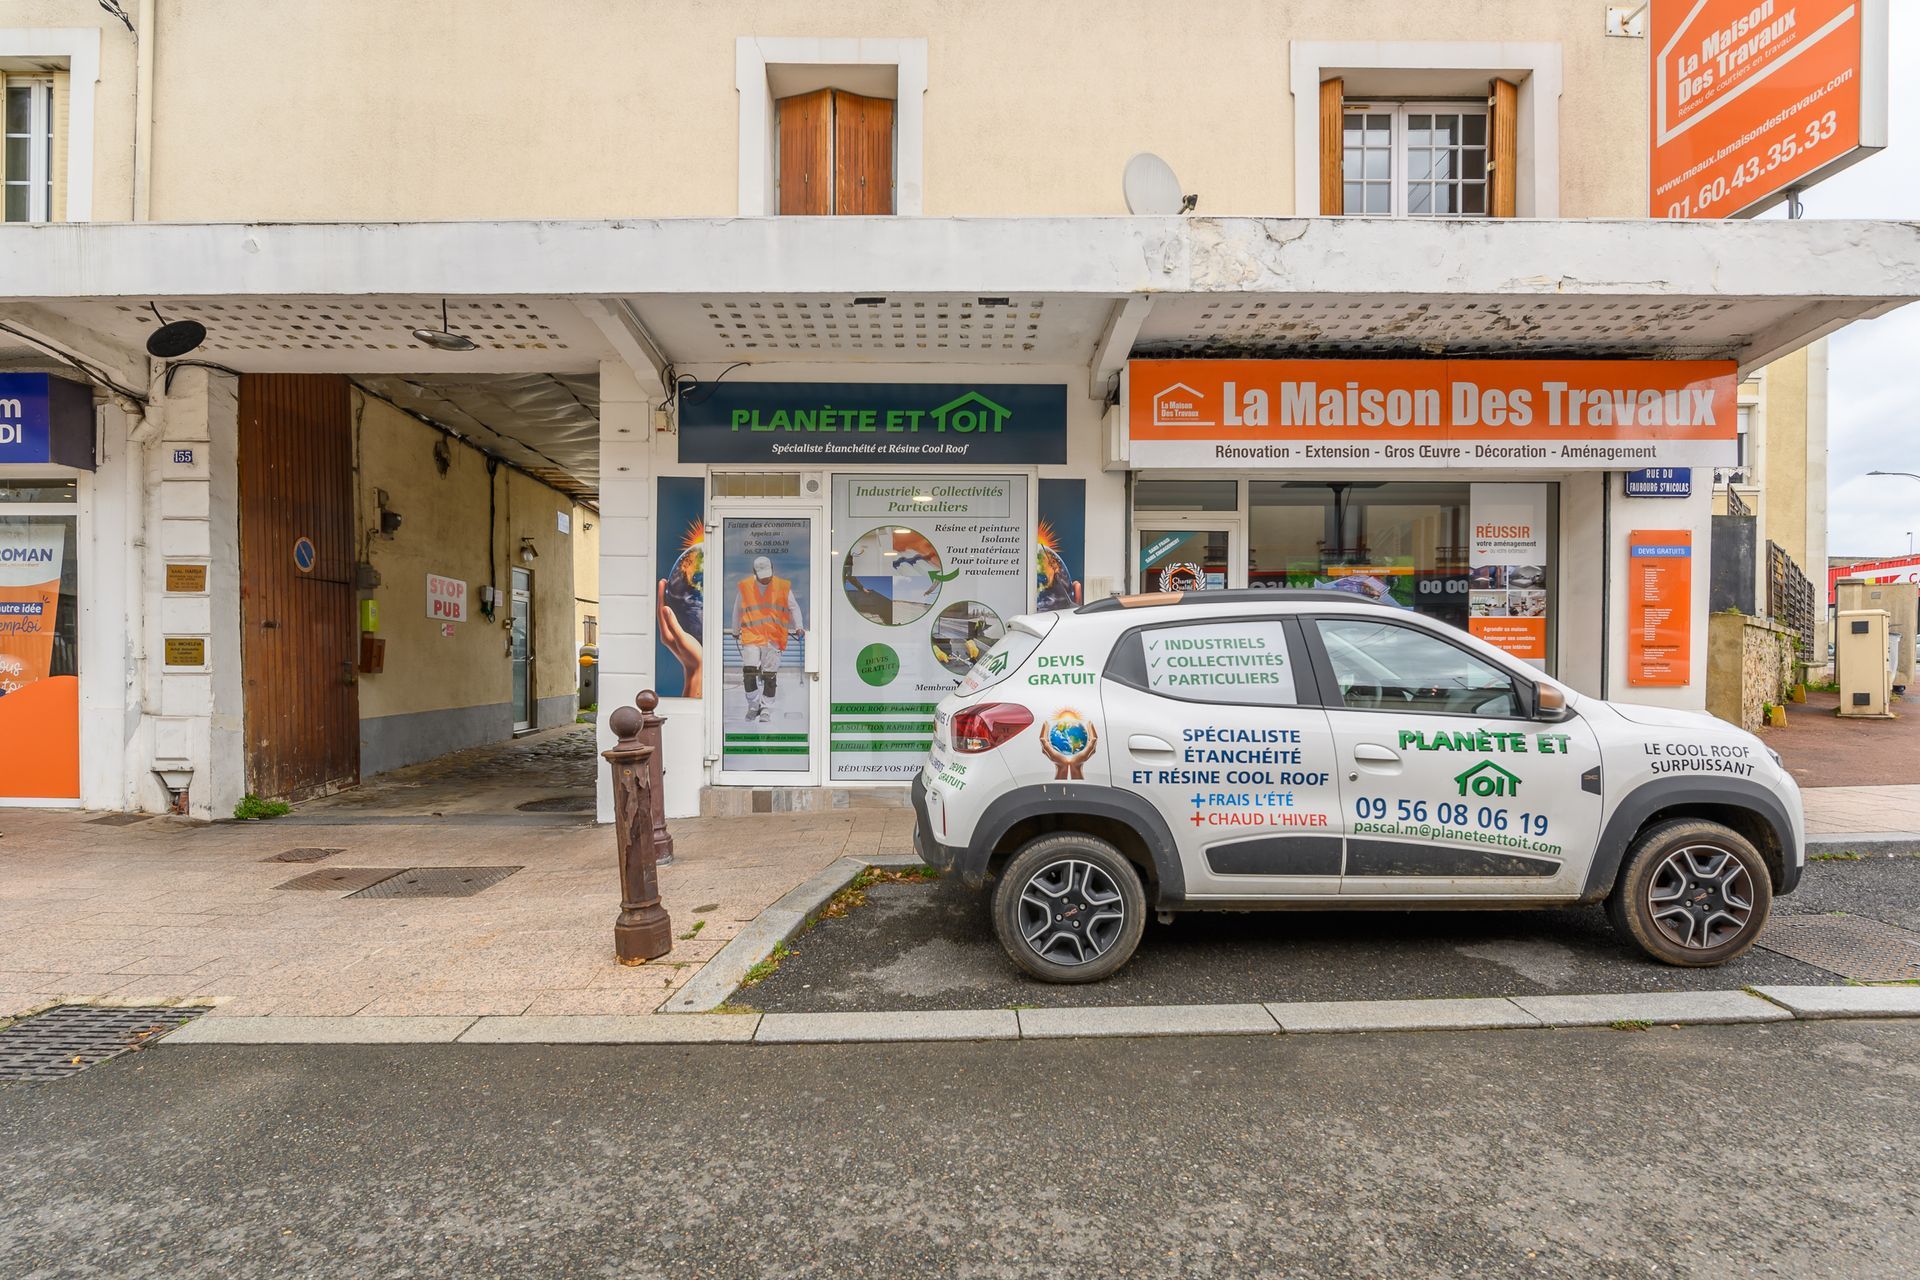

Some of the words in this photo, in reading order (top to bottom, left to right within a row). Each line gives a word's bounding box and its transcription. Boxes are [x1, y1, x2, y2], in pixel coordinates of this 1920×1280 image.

[1678, 54, 1698, 81] La
[1702, 0, 1774, 64] Maison
[1678, 68, 1713, 106] Des
[1716, 8, 1796, 78] Travaux
[1678, 97, 1704, 118] Réseau
[1705, 89, 1715, 100] de
[1716, 64, 1751, 92] courtiers
[1752, 56, 1763, 68] en
[1765, 32, 1796, 58] travaux
[1656, 67, 1853, 196] www.meaux.lamaisondestravaux.com
[1667, 110, 1837, 219] 01.60.43.35.33
[1223, 382, 1269, 426] La
[1280, 382, 1440, 426] Maison
[1452, 382, 1533, 426] Des
[1542, 382, 1716, 426] Travaux
[731, 405, 877, 434] PLANÈTE
[886, 410, 925, 433] ET
[929, 391, 1012, 433] TOIT
[772, 443, 824, 455] Spécialiste
[825, 441, 877, 454] Étanchéité
[878, 445, 887, 454] et
[889, 443, 920, 454] Résine
[922, 443, 944, 454] Cool
[945, 443, 969, 455] Roof
[1215, 445, 1290, 458] Rénovation
[1305, 445, 1370, 458] Extension
[1385, 445, 1414, 458] Gros
[1419, 445, 1460, 458] Œuvre
[1475, 444, 1547, 458] Décoration
[1561, 444, 1657, 461] Aménagement
[175, 451, 192, 462] 155
[1646, 469, 1659, 478] RUE
[1663, 469, 1673, 478] DU
[856, 486, 921, 497] Industriels
[931, 486, 1003, 497] Collectivités
[1630, 483, 1658, 492] FAUBOURG
[887, 501, 968, 512] Particuliers
[935, 524, 966, 533] Résine
[968, 525, 977, 533] et
[979, 525, 1020, 534] peinture
[1476, 523, 1530, 538] RÉUSSIR
[981, 535, 1020, 543] Isolante
[0, 548, 53, 561] OMAN
[946, 546, 968, 554] Tout
[970, 546, 1020, 554] matériaux
[951, 557, 974, 565] Pour
[976, 557, 1009, 565] toiture
[1011, 557, 1020, 565] et
[965, 568, 1020, 576] ravalement
[430, 578, 464, 598] STOP
[0, 604, 20, 613] utre
[22, 603, 42, 613] idée
[434, 600, 460, 618] PUB
[1164, 638, 1266, 651] INDUSTRIELS
[865, 656, 888, 665] DEVIS
[1037, 655, 1085, 668] DEVIS
[1166, 653, 1284, 668] COLLECTIVITÉS
[1028, 672, 1096, 686] GRATUIT
[1168, 672, 1280, 686] PARTICULIERS
[915, 684, 957, 692] Membran
[1182, 726, 1301, 744] SPÉCIALISTE
[1398, 728, 1527, 753] PLANÈTE
[1536, 733, 1571, 754] ET
[1184, 747, 1302, 764] ÉTANCHÉITÉ
[1644, 743, 1661, 755] LE
[1665, 743, 1705, 757] COOL
[1710, 745, 1750, 759] ROOF
[838, 764, 883, 772] RÉDUISEZ
[1651, 758, 1755, 776] SURPUISSANT
[1132, 771, 1153, 784] ET
[1158, 768, 1220, 785] RÉSINE
[1226, 771, 1275, 785] COOL
[1280, 772, 1329, 786] ROOF
[1454, 759, 1522, 797] TOIT
[1355, 797, 1387, 820] 09
[1398, 799, 1428, 822] 56
[1437, 802, 1468, 826] 08
[1477, 807, 1508, 831] 06
[1520, 812, 1549, 837] 19
[1354, 820, 1562, 855] pascal.m@planeteettoit.com
